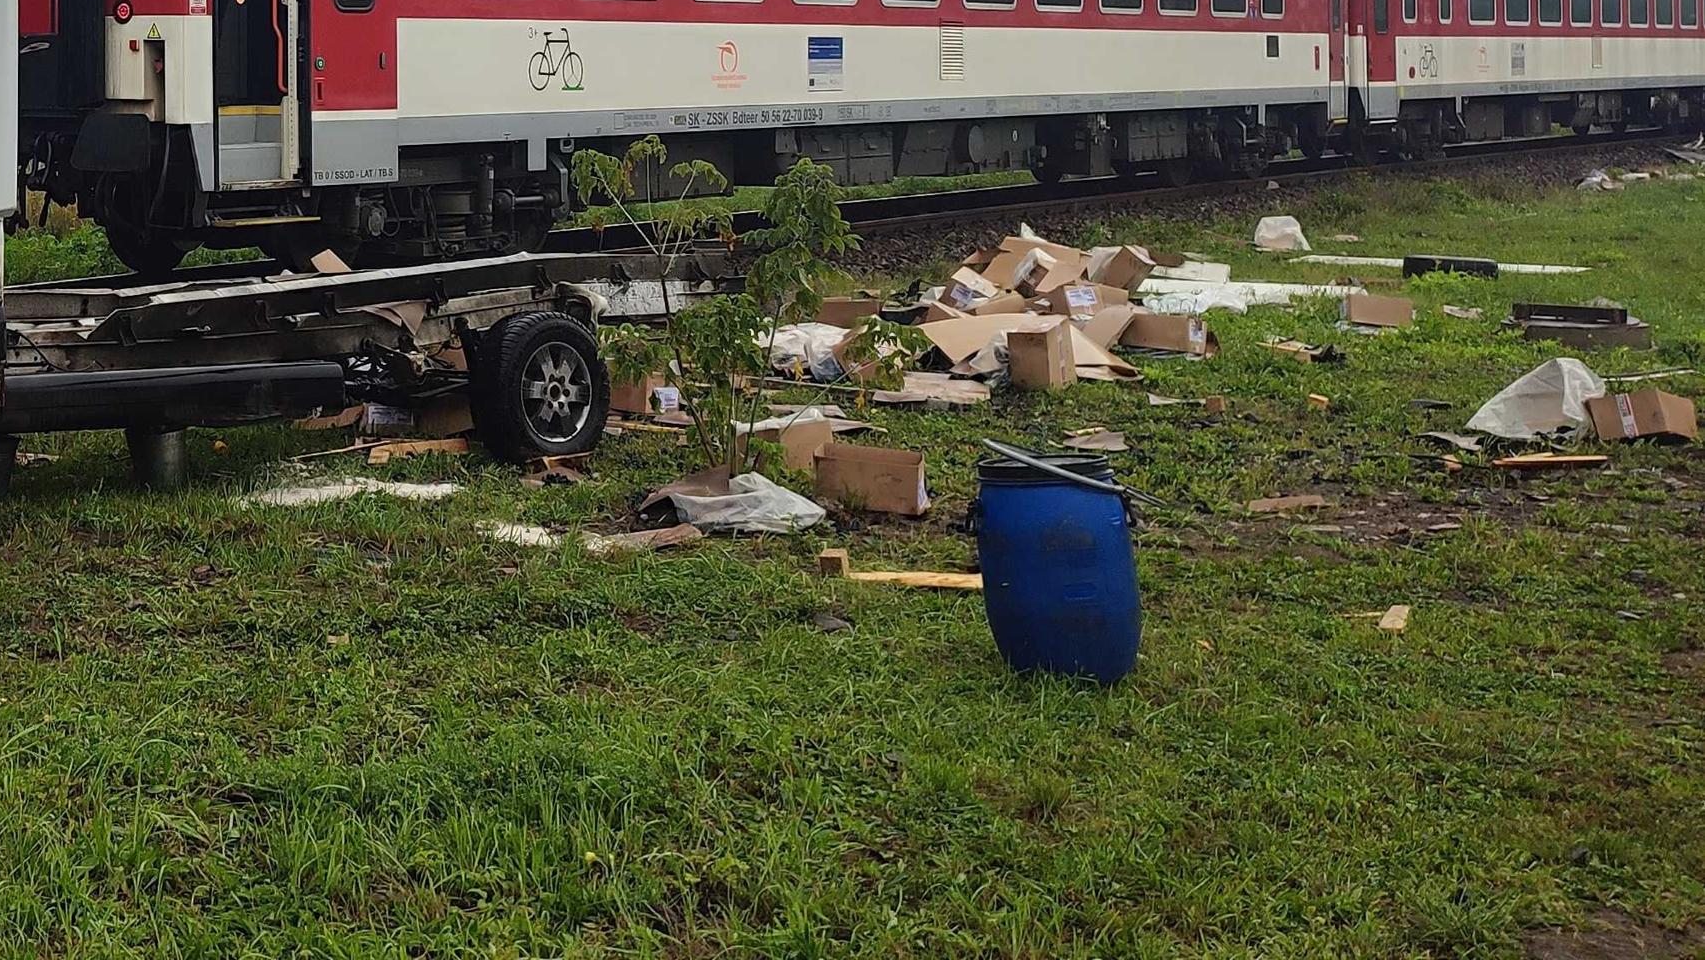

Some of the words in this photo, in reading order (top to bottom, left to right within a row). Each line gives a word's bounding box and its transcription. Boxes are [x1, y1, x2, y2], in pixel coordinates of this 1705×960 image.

[688, 112, 700, 126] SK
[707, 111, 729, 125] ZSSK
[761, 110, 769, 123] 50
[771, 109, 780, 122] 56
[314, 171, 324, 180] TB
[360, 169, 373, 178] LAT
[378, 168, 387, 177] TB
